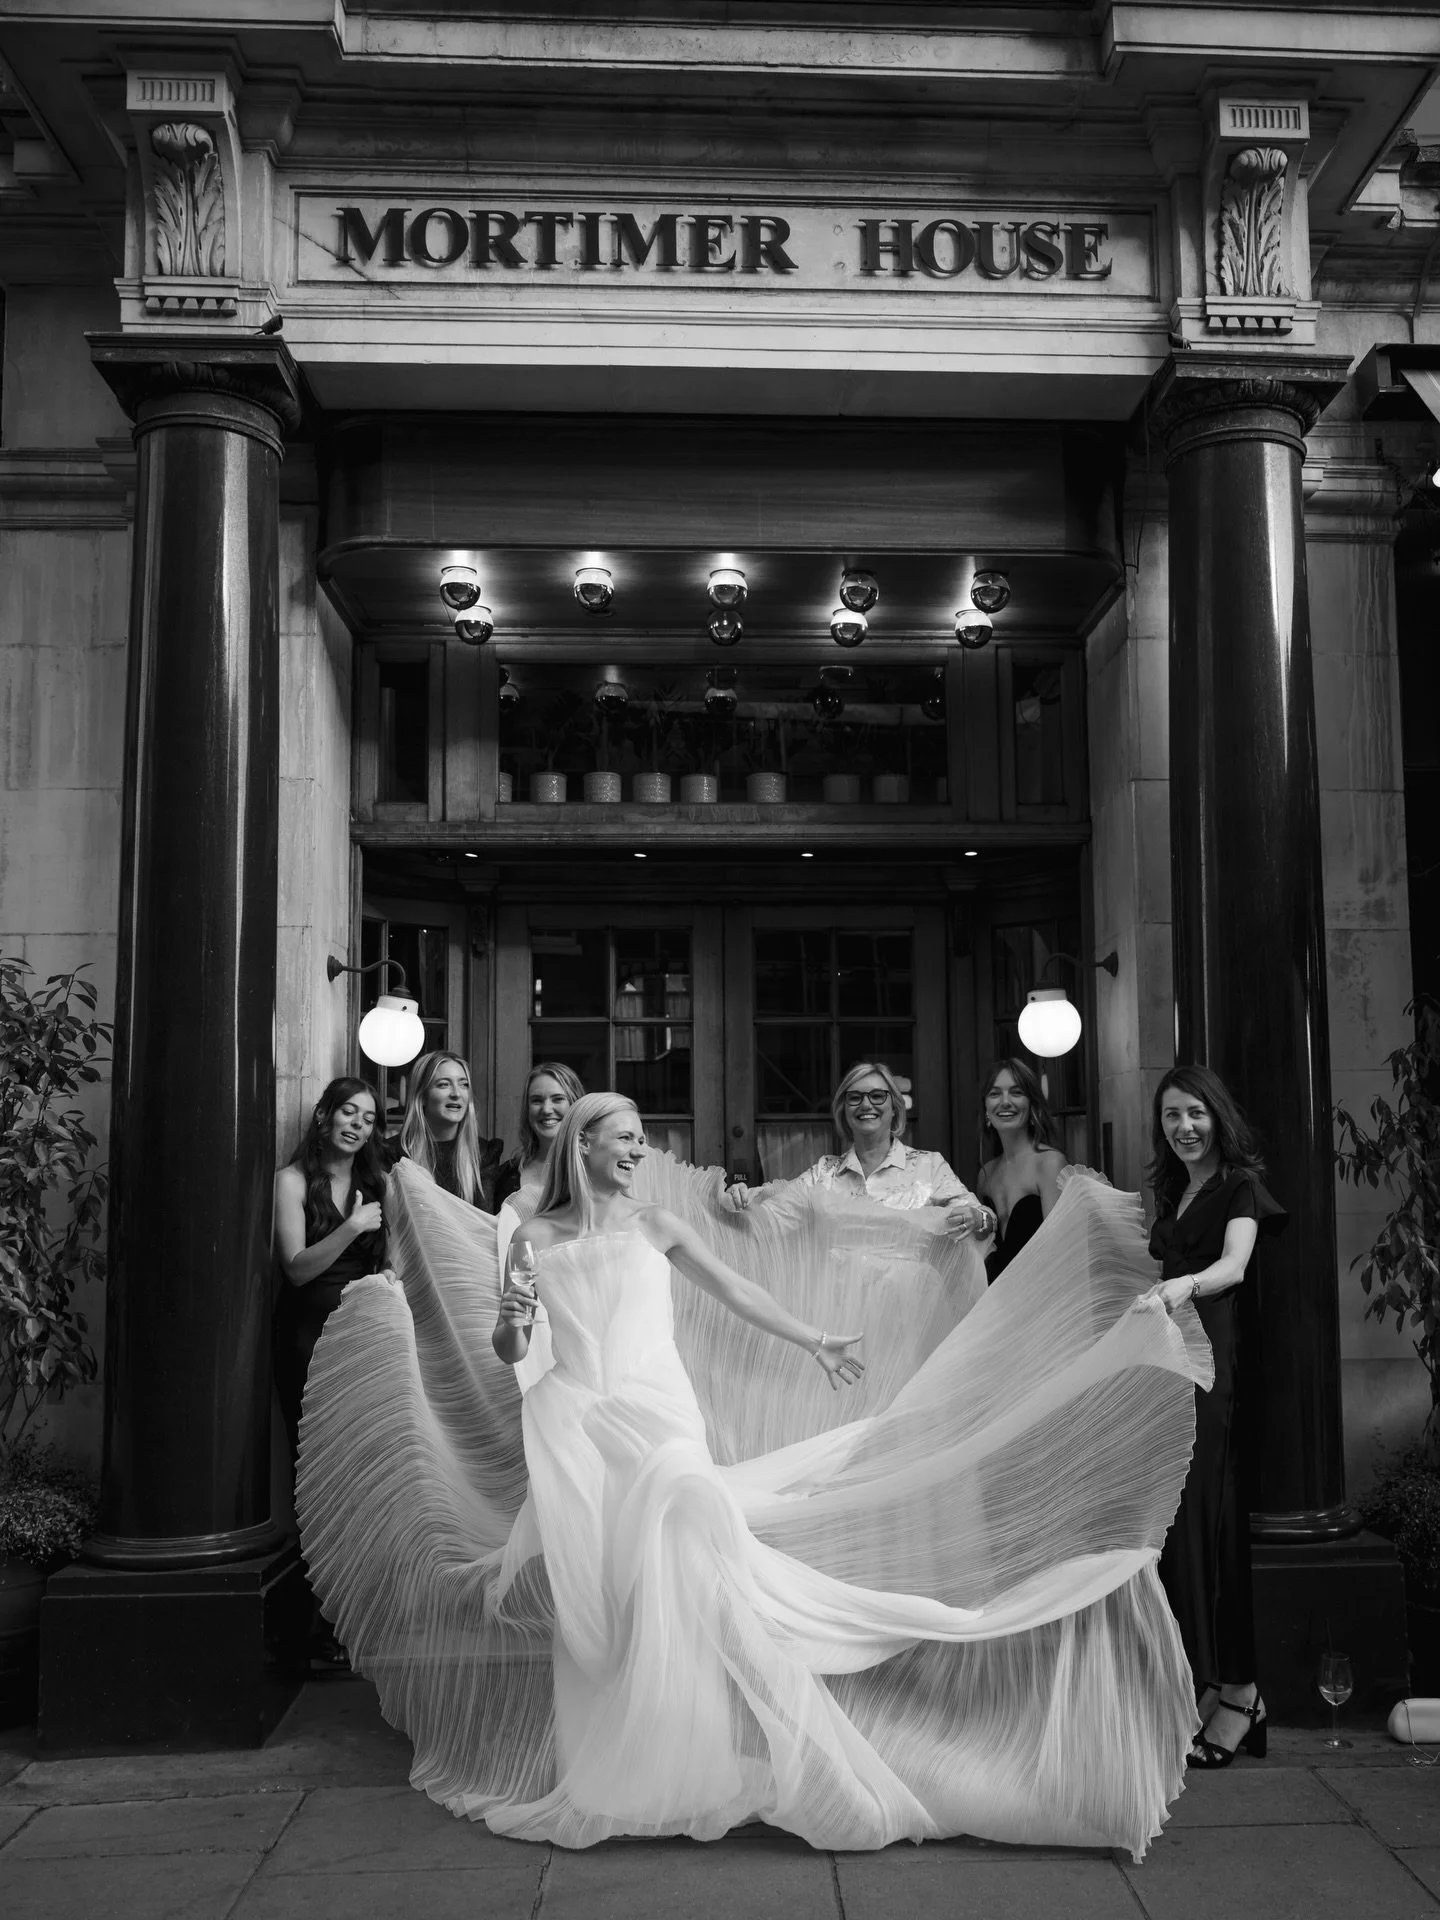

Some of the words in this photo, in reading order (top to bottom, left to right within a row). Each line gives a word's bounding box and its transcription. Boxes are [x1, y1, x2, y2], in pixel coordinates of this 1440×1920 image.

[335, 207, 799, 270] MORTIMER
[858, 219, 1113, 277] HOUSE
[734, 1173, 747, 1181] PULL
